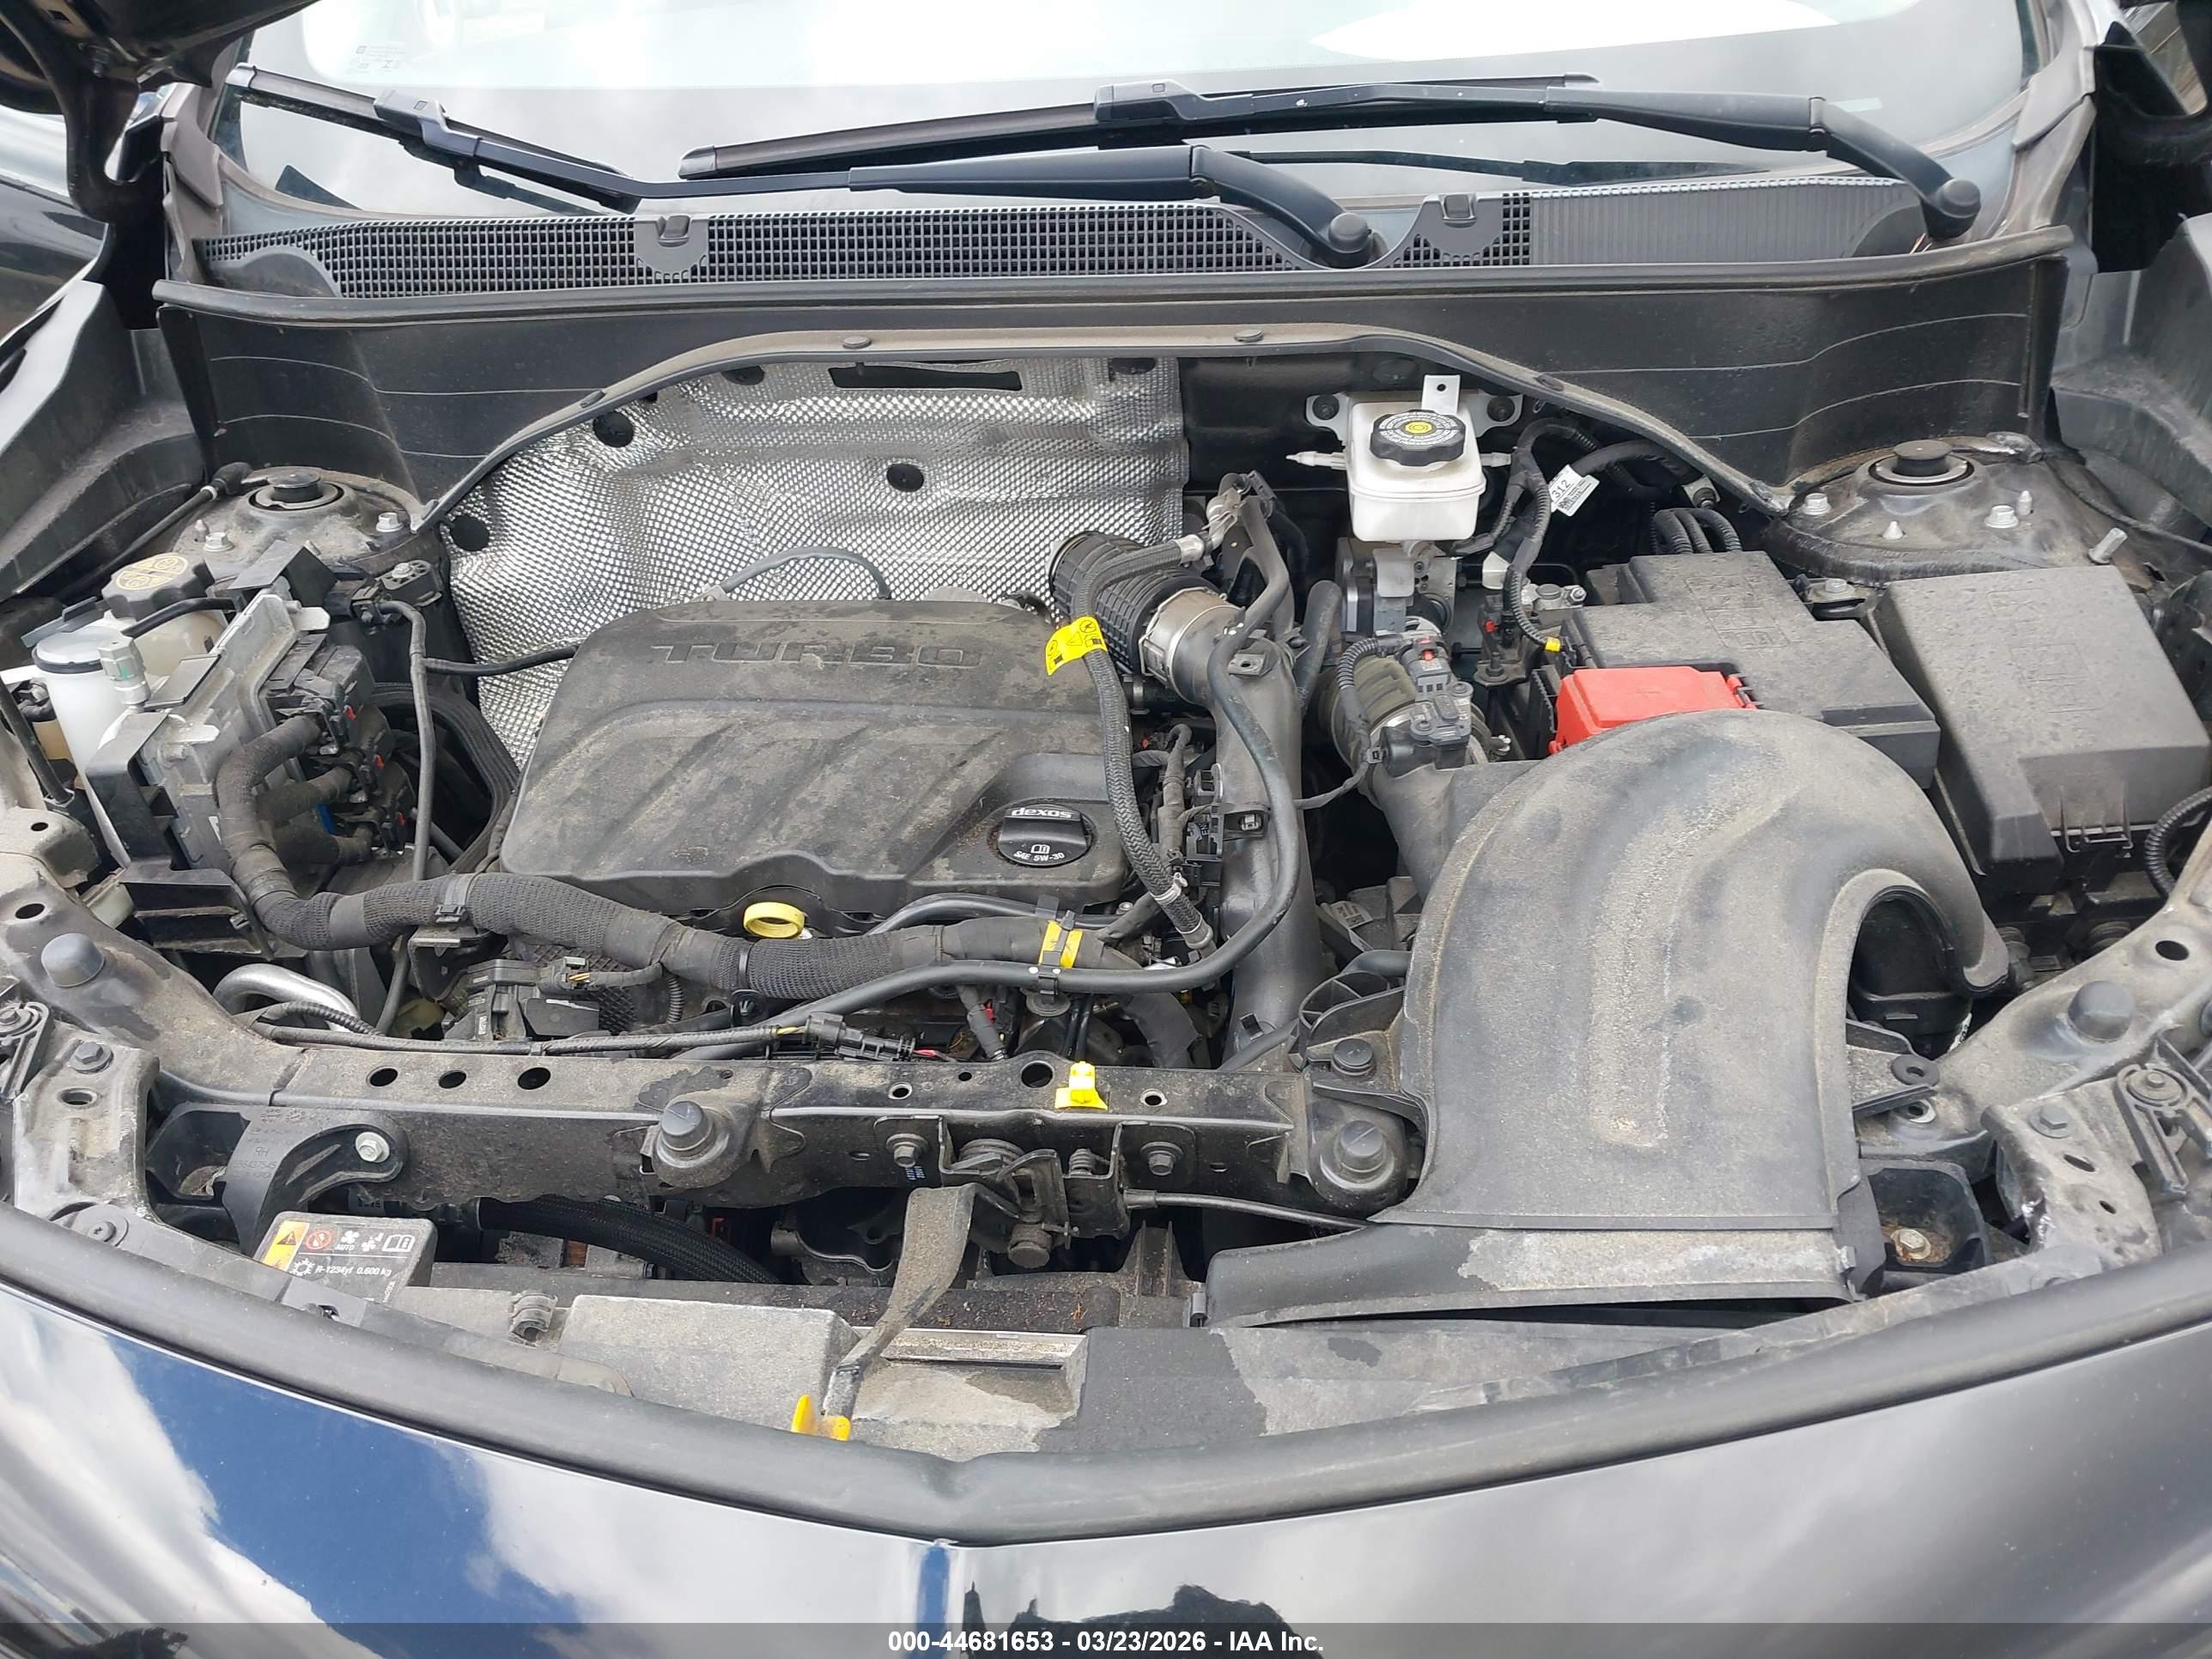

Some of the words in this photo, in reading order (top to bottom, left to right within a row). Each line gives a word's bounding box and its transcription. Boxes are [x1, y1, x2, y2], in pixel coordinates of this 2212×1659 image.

[1552, 479, 1571, 498] 312
[650, 642, 983, 669] TURBO
[1011, 807, 1073, 819] dexos
[1013, 850, 1031, 860] SAE
[1033, 852, 1066, 862] 5W-30
[314, 1266, 355, 1276] R-1234yf
[380, 1268, 392, 1277] kg
